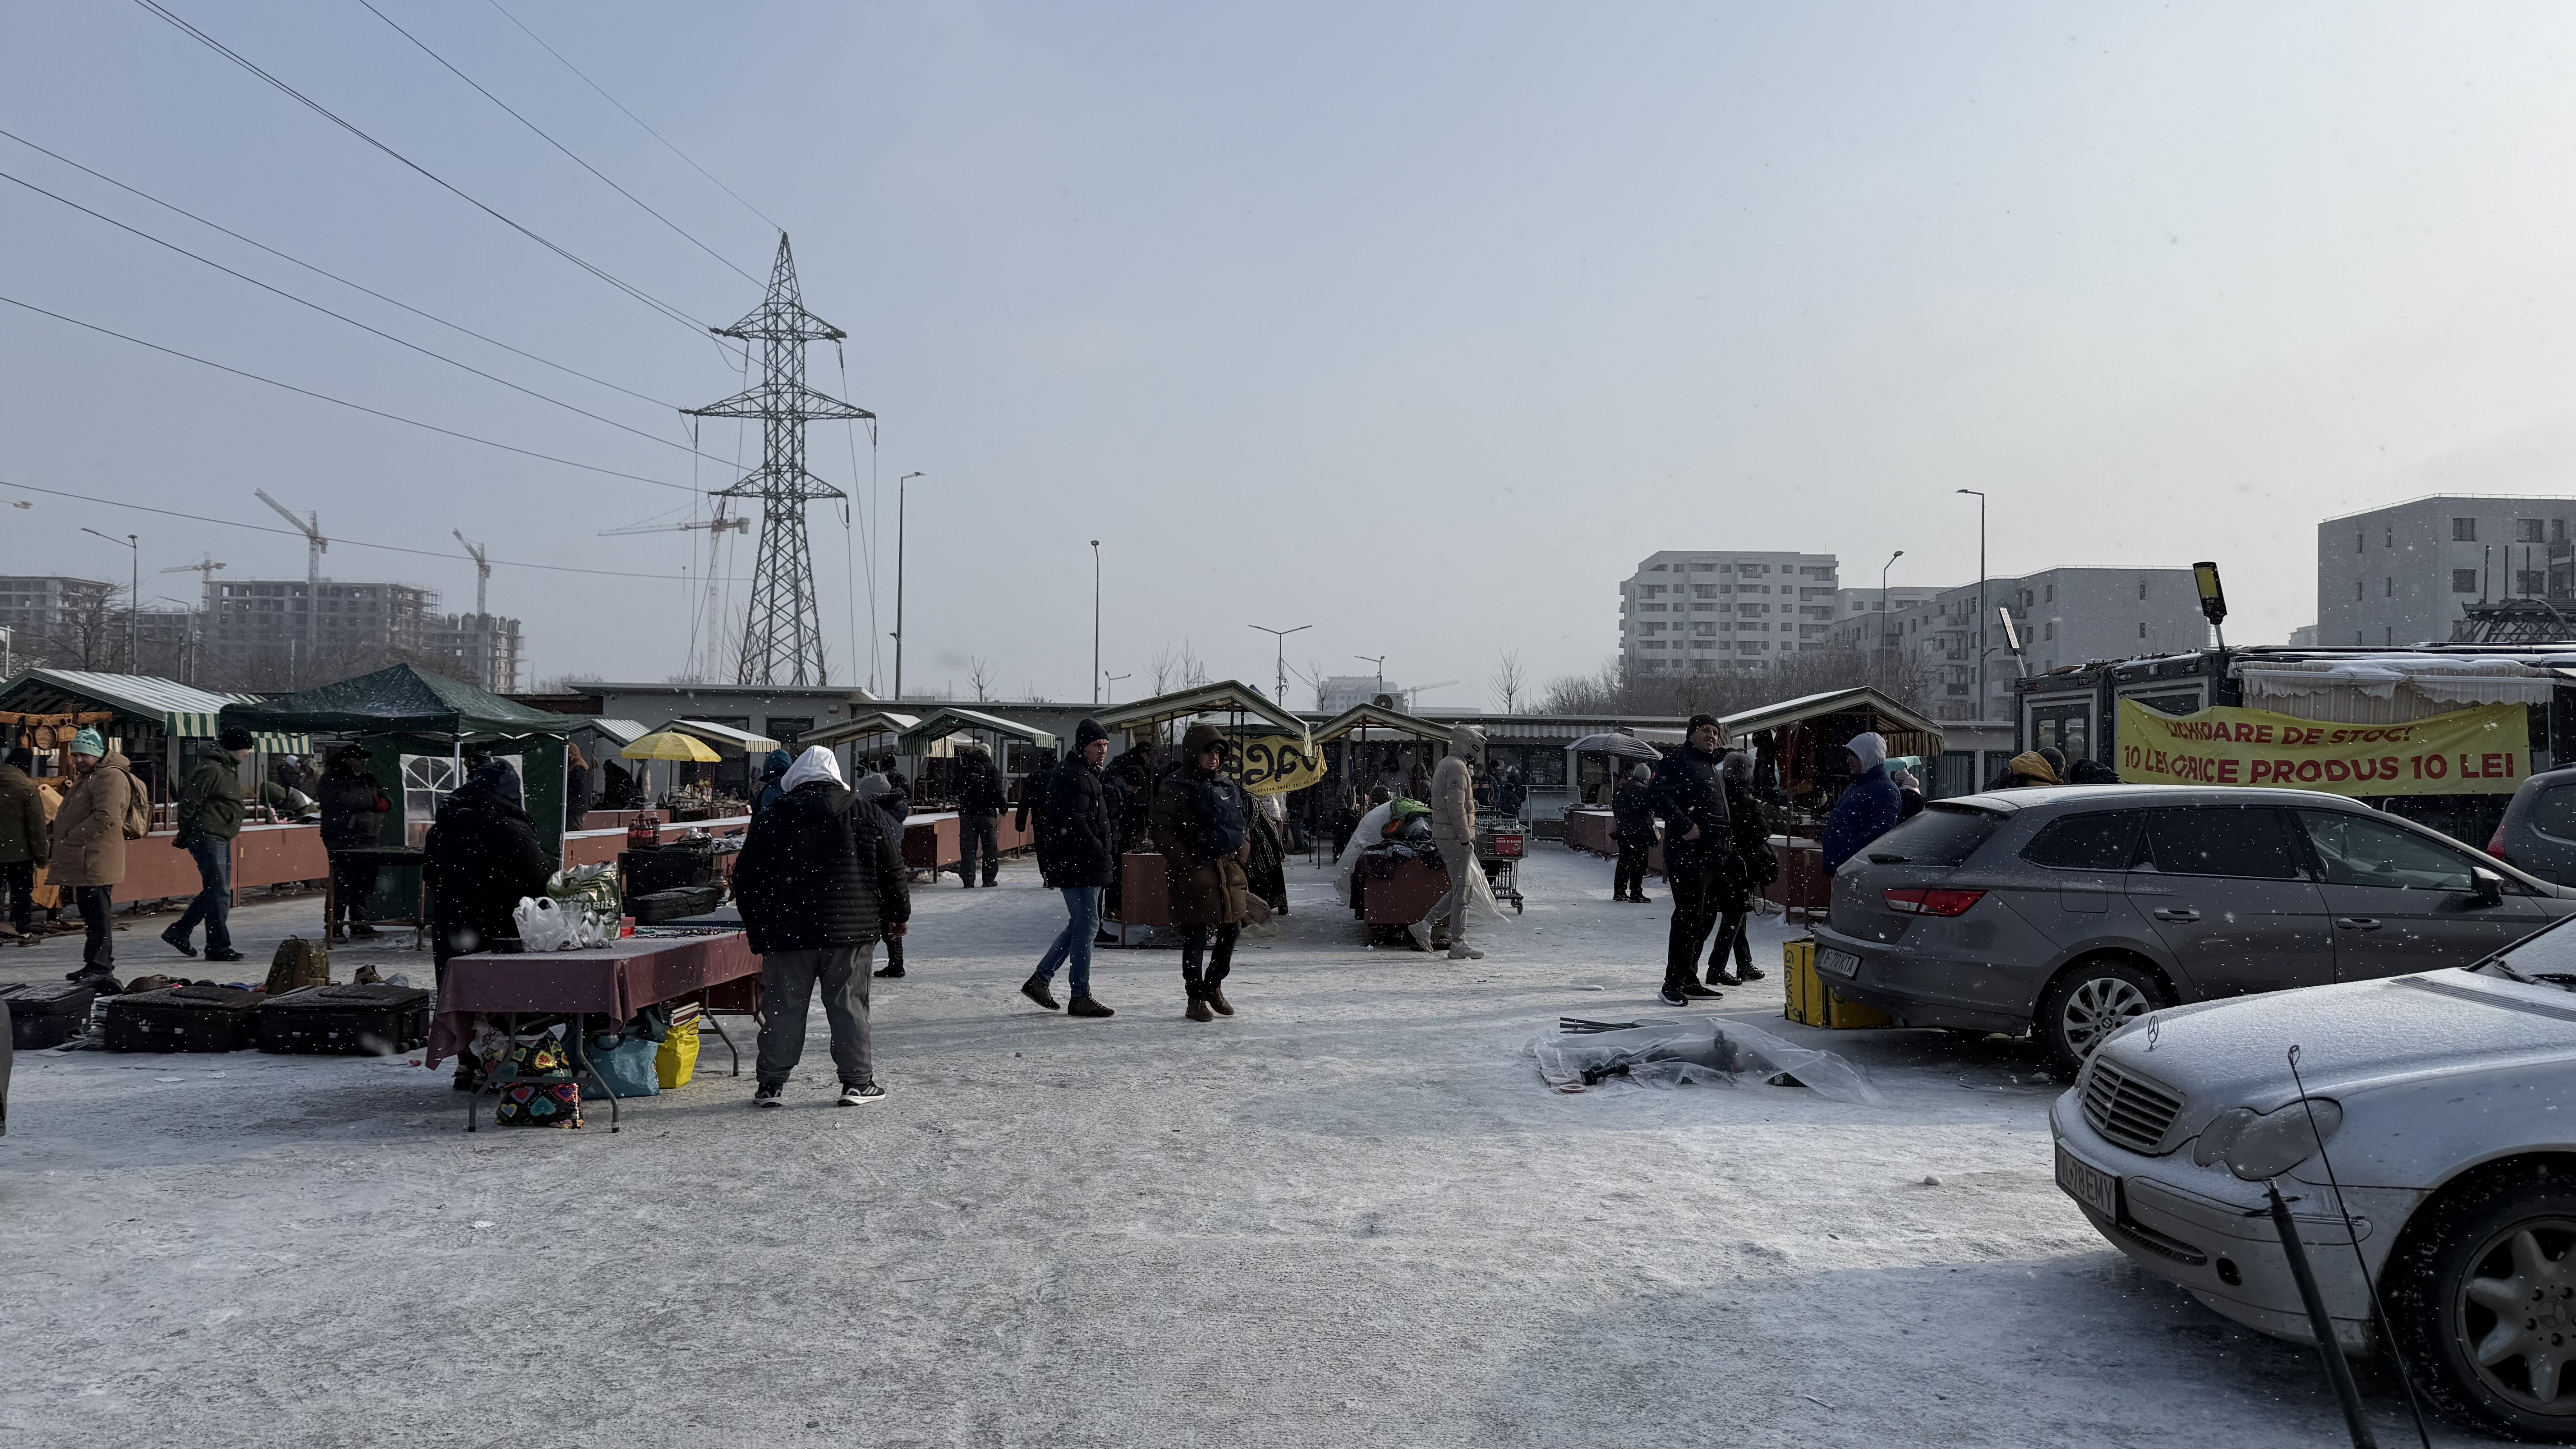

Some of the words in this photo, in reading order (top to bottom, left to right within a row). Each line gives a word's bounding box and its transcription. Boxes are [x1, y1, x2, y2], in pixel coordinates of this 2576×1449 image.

[2164, 721, 2273, 743] LICHIDARE
[2281, 727, 2324, 745] DE
[2327, 727, 2416, 744] STOC!
[2125, 745, 2141, 769] 10
[2171, 754, 2240, 783] ORICE
[2249, 756, 2399, 784] PRODUS
[2411, 754, 2447, 779] 10
[2460, 753, 2514, 778] LEI
[1785, 949, 1794, 1007] Glovo
